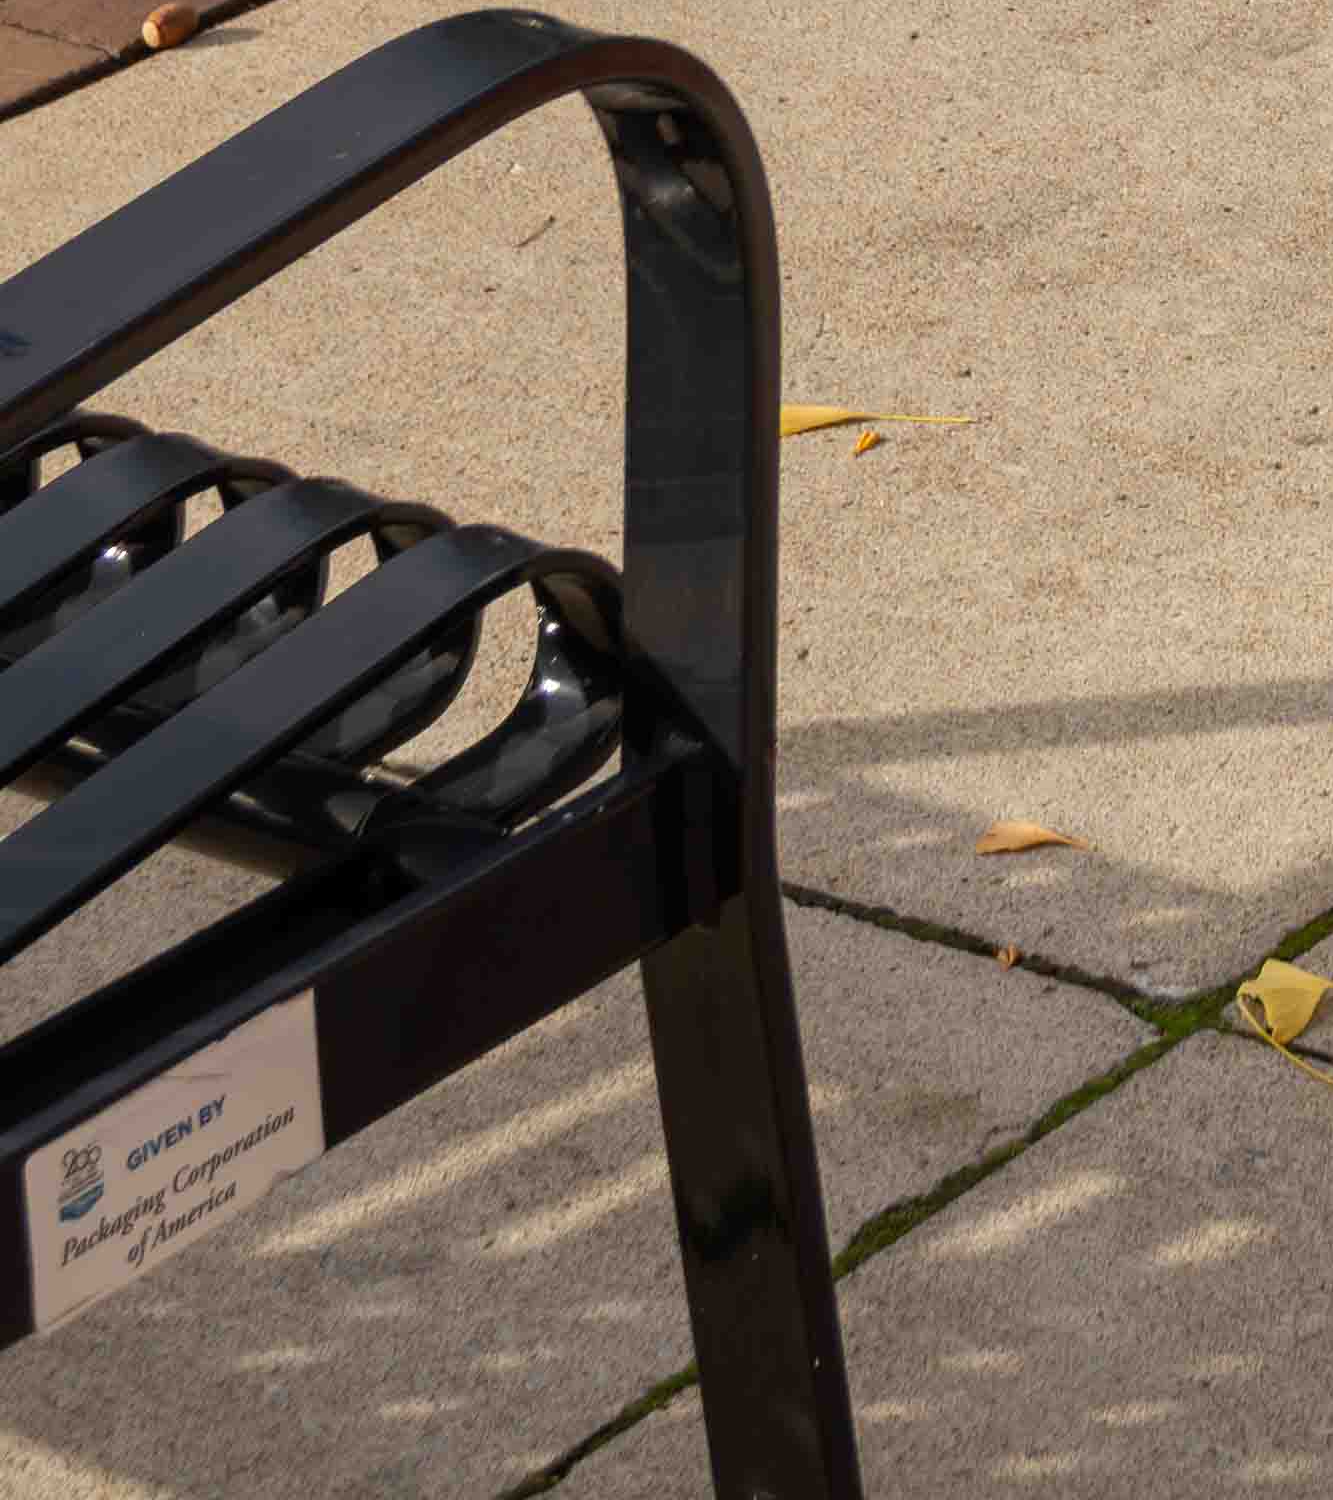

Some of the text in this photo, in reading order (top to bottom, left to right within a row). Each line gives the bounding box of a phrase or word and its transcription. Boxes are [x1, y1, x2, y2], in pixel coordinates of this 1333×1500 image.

[126, 1093, 227, 1171] GIVEN BY
[60, 1106, 295, 1267] Packaging Corporation
[127, 1225, 153, 1268] of
[151, 1180, 237, 1250] America
